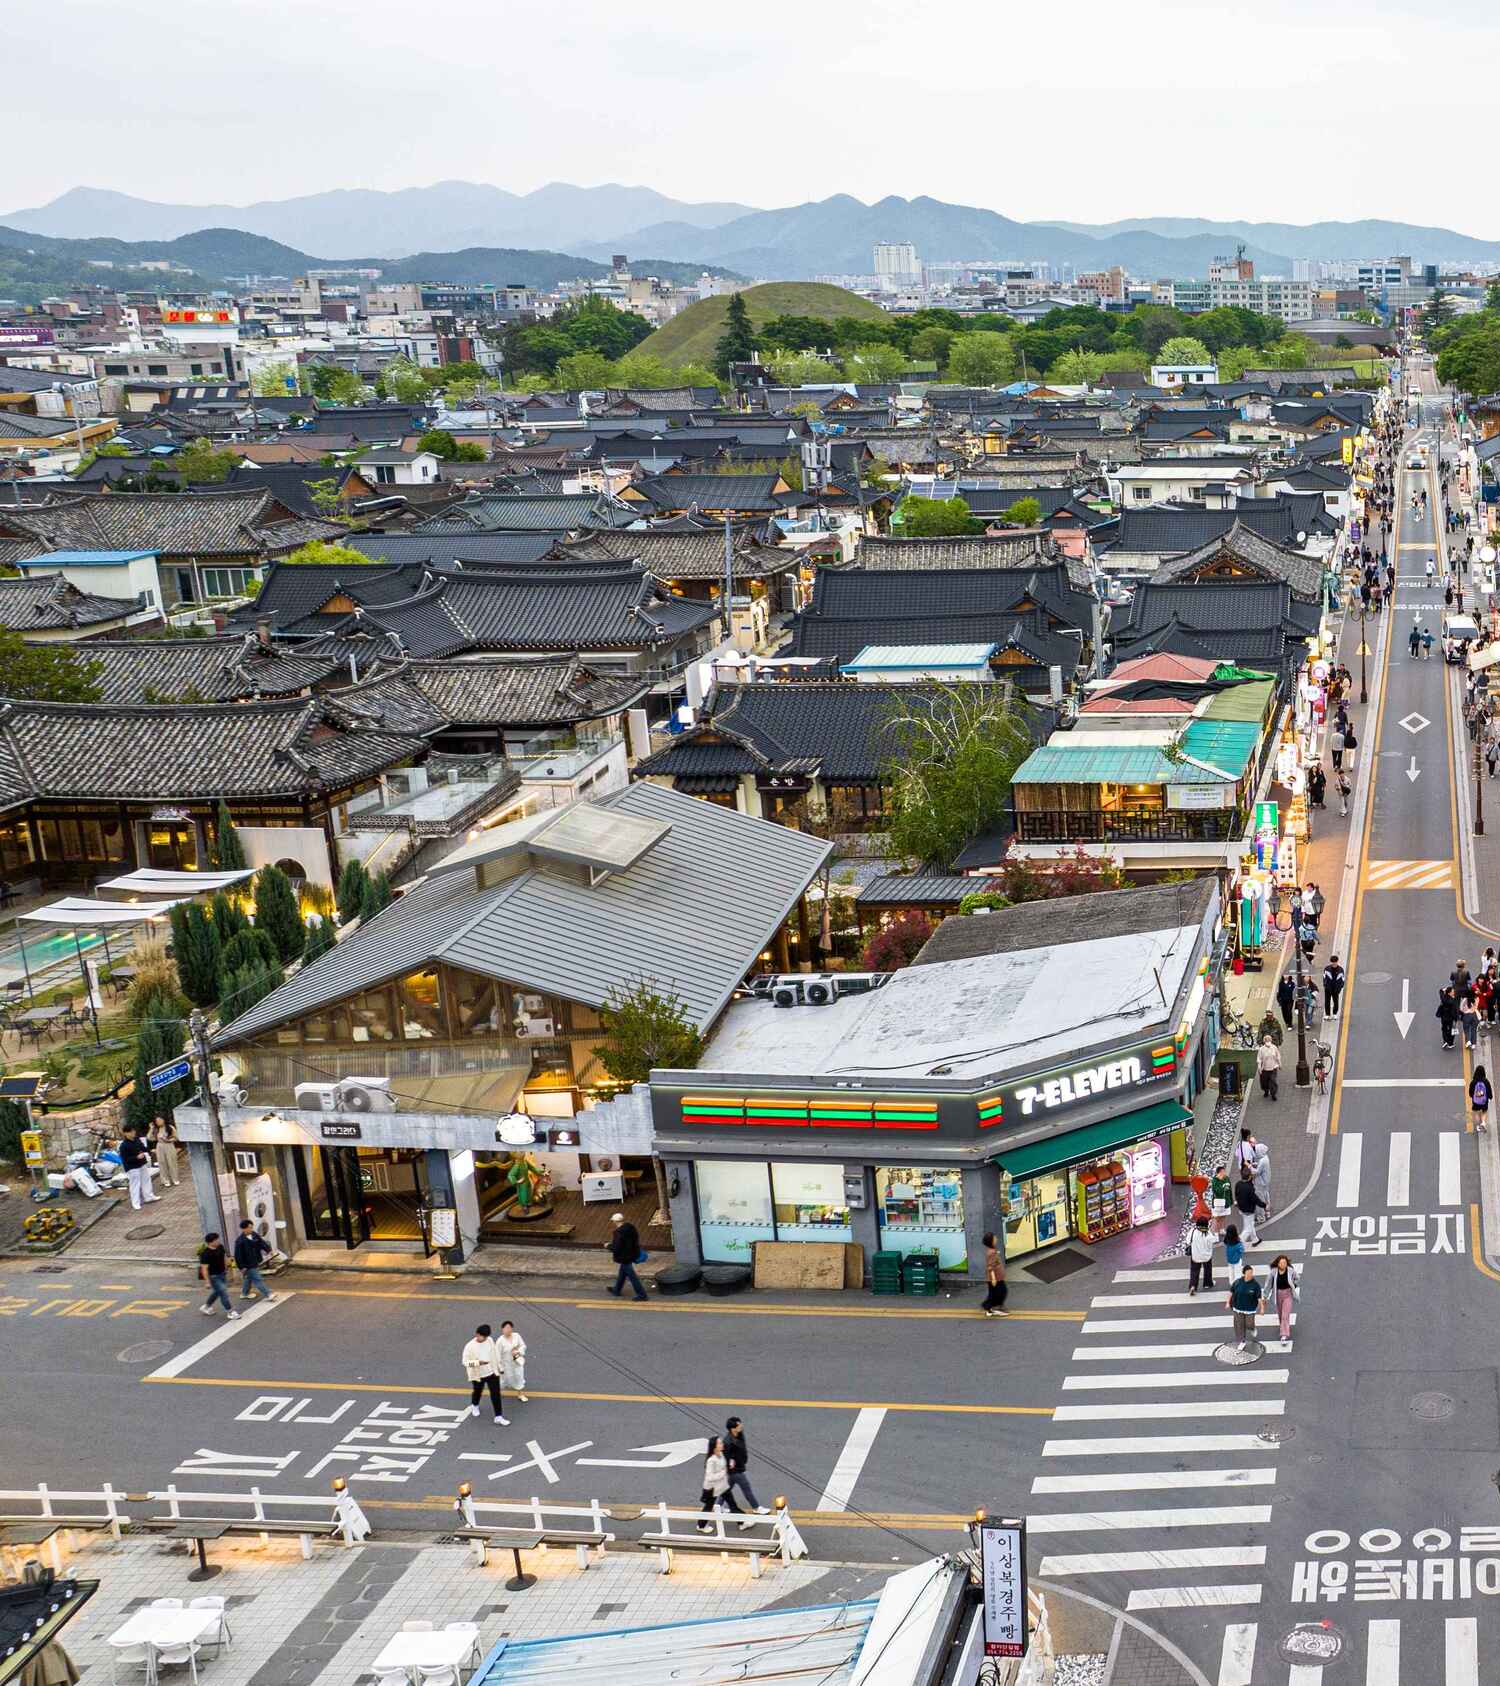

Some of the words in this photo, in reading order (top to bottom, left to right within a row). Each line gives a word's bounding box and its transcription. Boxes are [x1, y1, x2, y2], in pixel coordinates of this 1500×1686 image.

[1311, 1213, 1466, 1257] 진입금지
[170, 1396, 356, 1478] 금지
[304, 1401, 472, 1483] 좌회전
[998, 1534, 1018, 1640] 이상복경주빵
